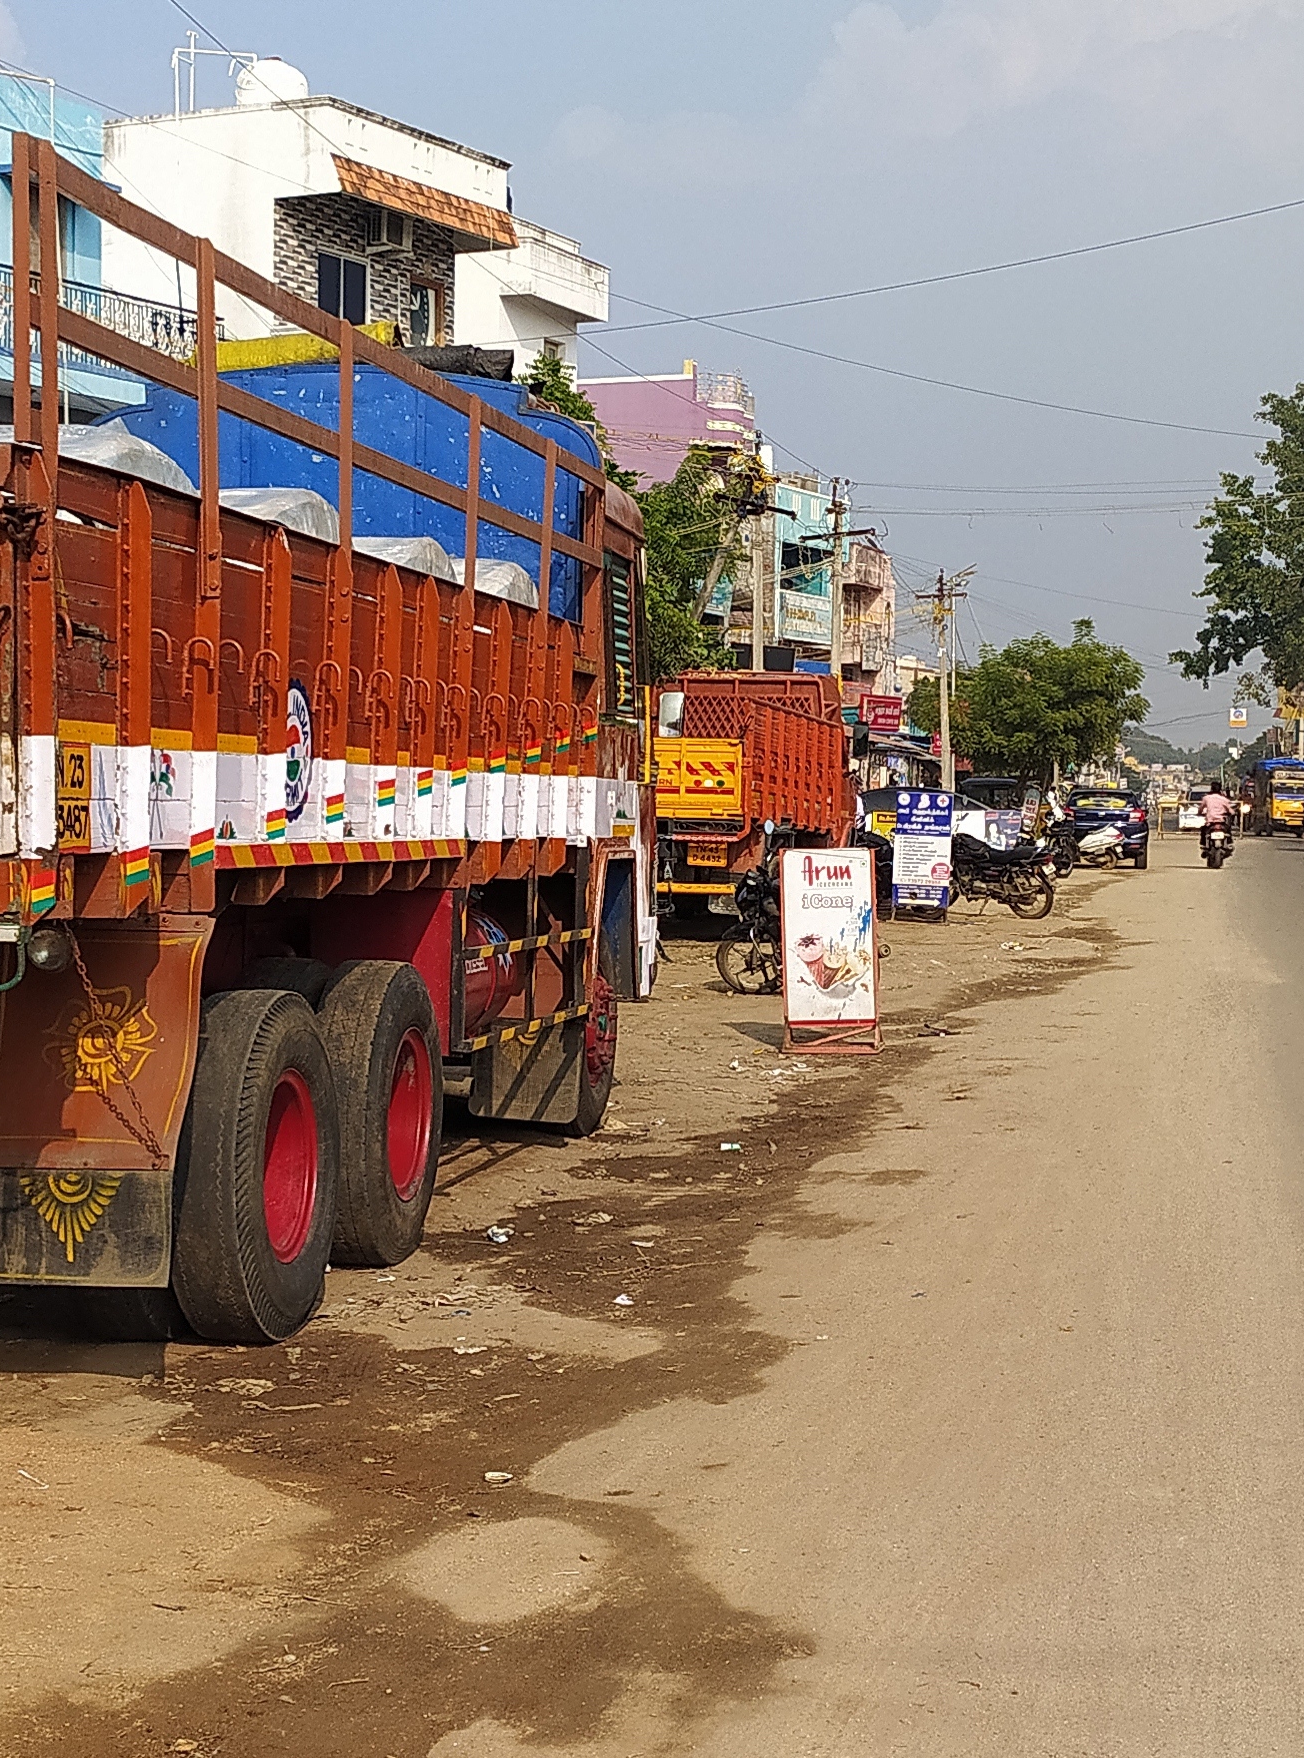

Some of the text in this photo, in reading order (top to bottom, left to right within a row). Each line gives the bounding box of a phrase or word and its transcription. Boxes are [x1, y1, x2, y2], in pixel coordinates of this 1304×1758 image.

[291, 695, 309, 749] INDIA
[801, 855, 852, 887] Arun
[802, 893, 853, 909] iCone
